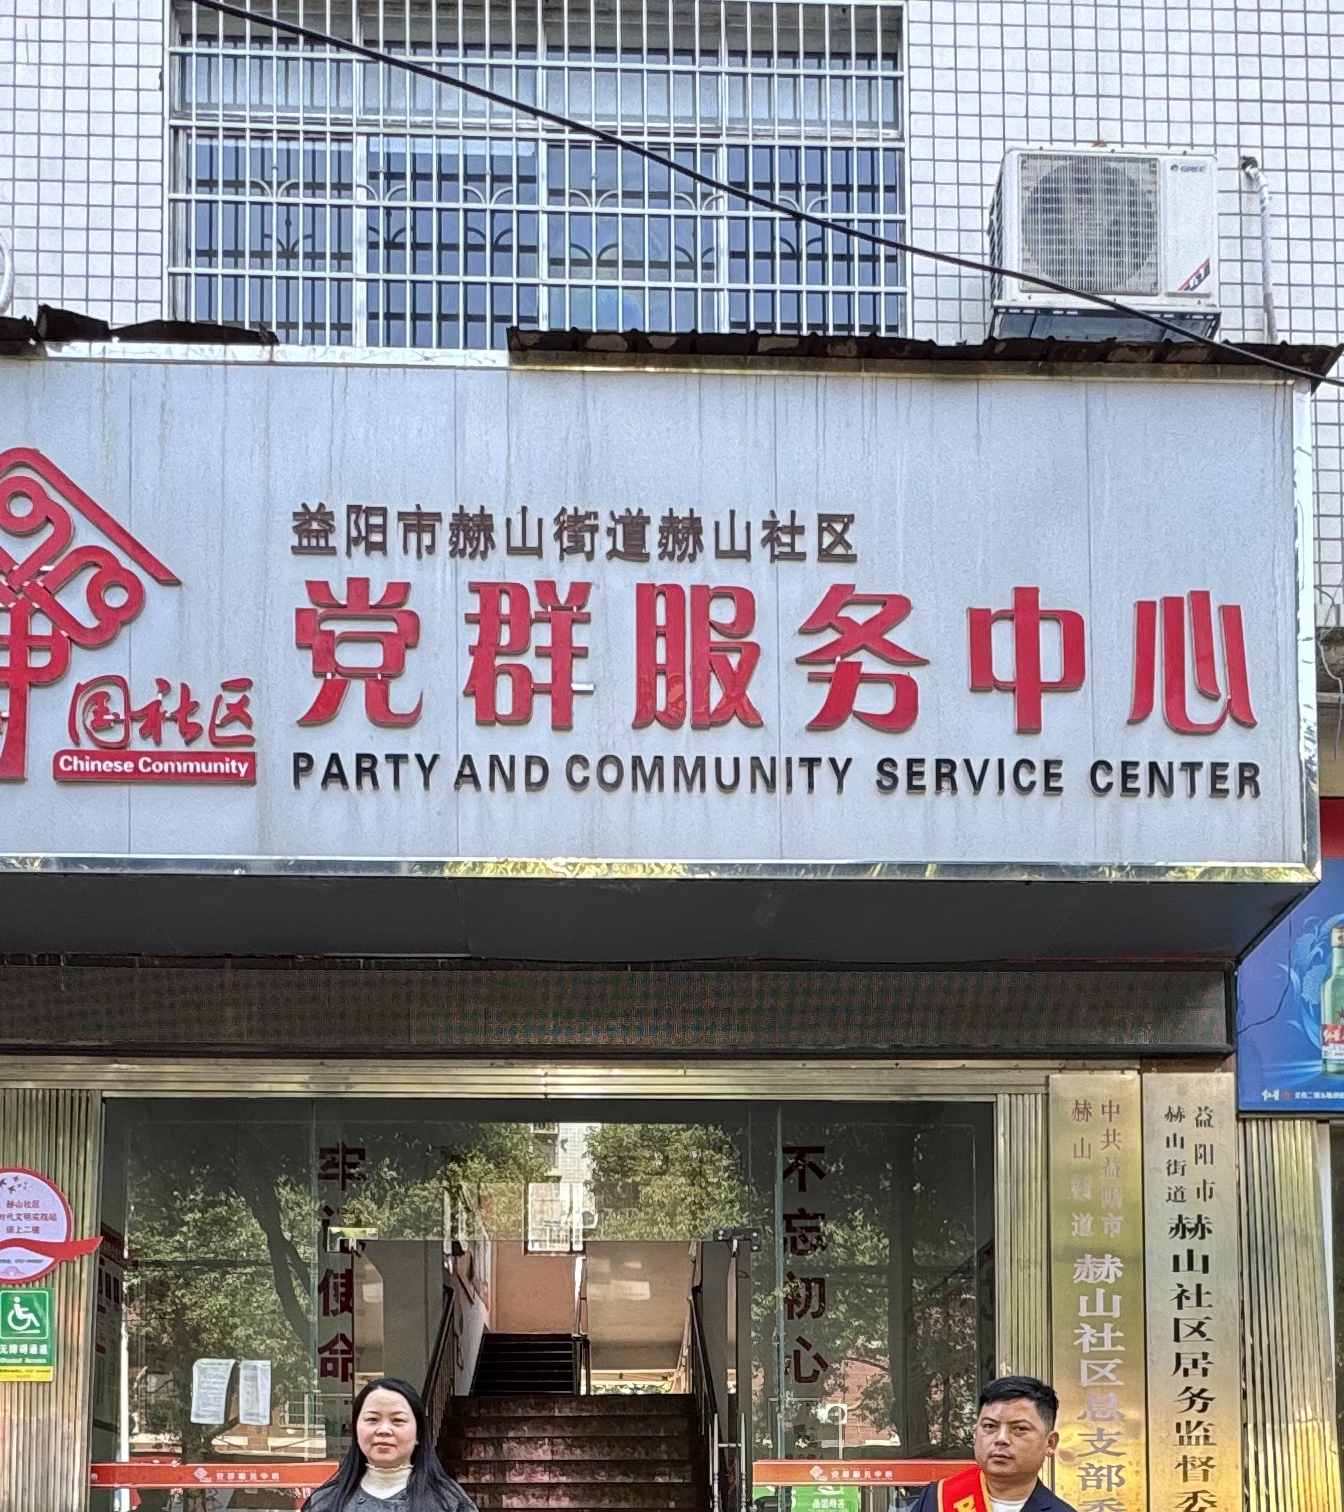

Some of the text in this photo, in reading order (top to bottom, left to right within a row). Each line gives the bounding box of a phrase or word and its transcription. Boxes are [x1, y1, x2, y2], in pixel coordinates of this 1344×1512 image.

[290, 502, 857, 564] 益阳市赫山街道赫山社区
[294, 576, 1258, 736] 党群服务中心
[58, 754, 250, 778] Chinese Community
[291, 752, 1262, 799] PARTY AND COMMUNITY SERVICE CENTER
[1071, 1099, 1094, 1238] 赫山街道
[1163, 1105, 1188, 1204] 赫山街道
[1194, 1105, 1216, 1203] 益阳市
[781, 1145, 829, 1385] 不忘初心
